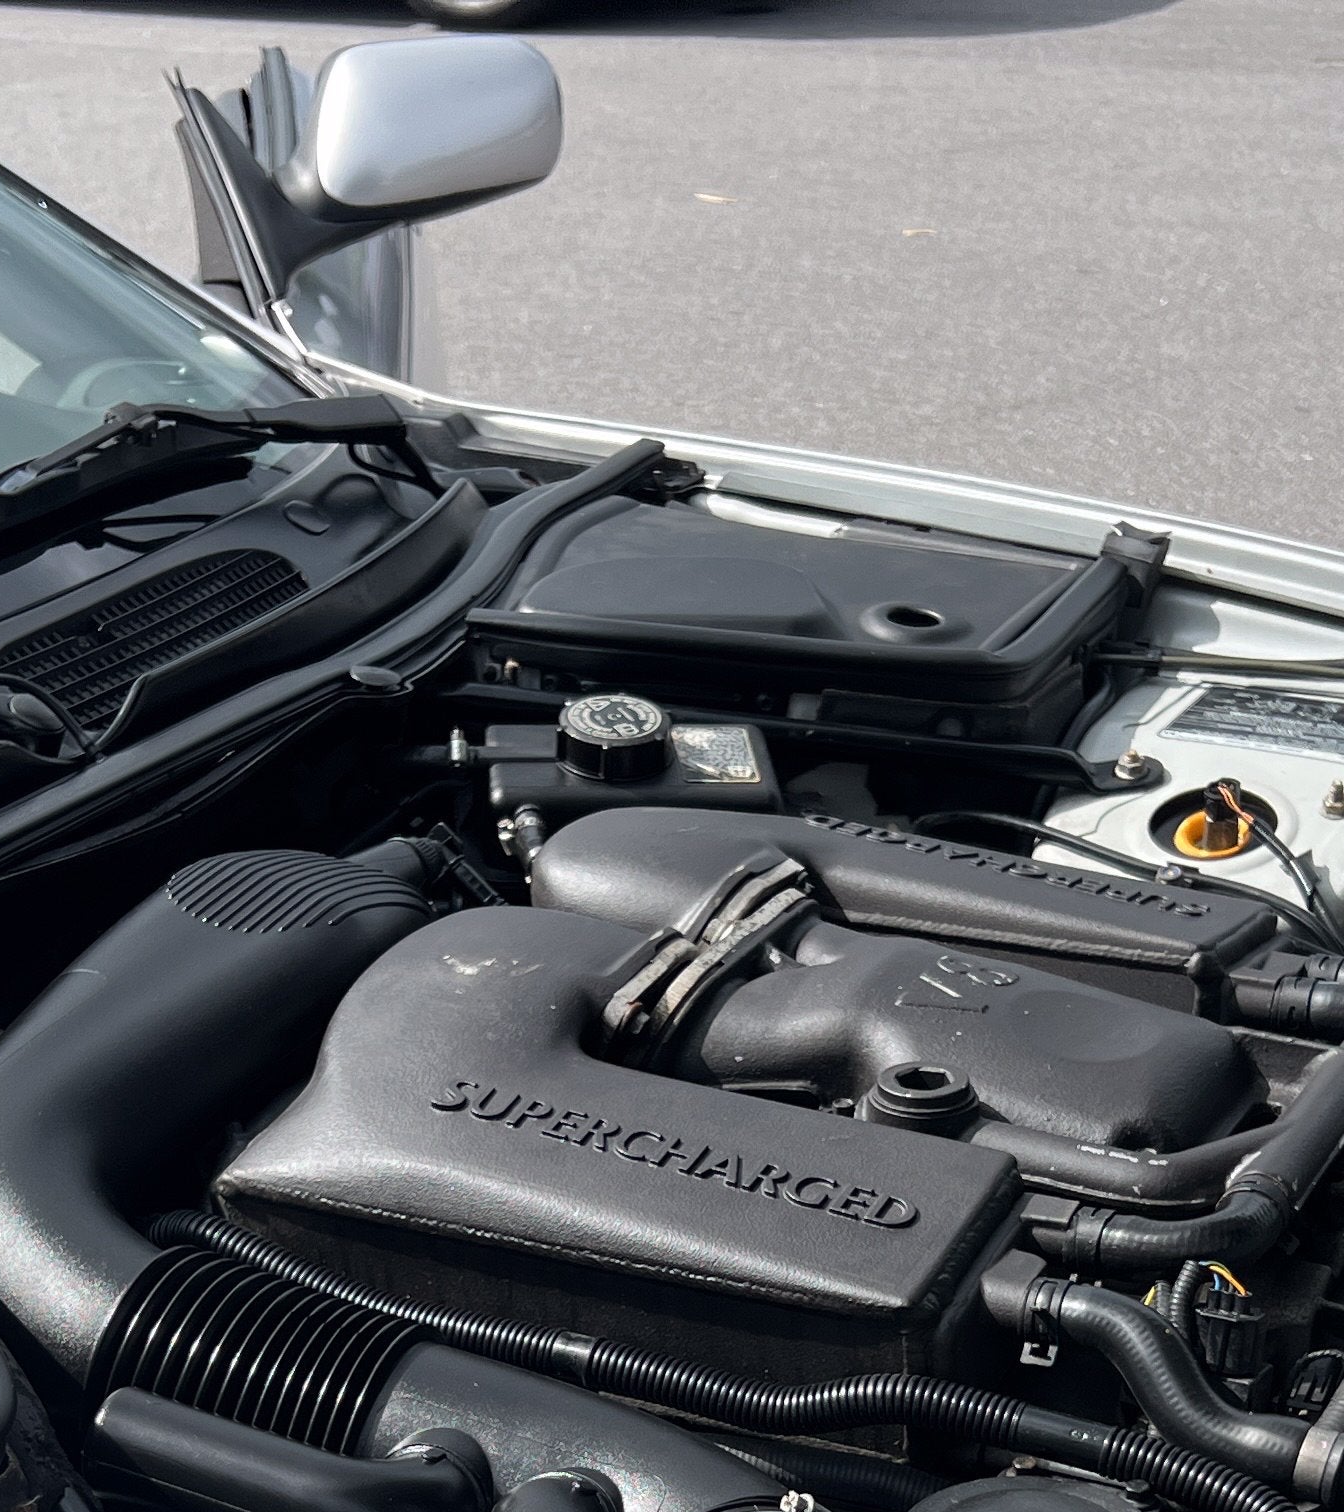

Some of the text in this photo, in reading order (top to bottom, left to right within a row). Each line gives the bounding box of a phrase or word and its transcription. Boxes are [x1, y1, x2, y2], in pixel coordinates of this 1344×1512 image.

[801, 811, 1211, 918] SUPERCHARGED
[894, 954, 1020, 1014] V8
[429, 1079, 921, 1229] SUPERCHARGED
